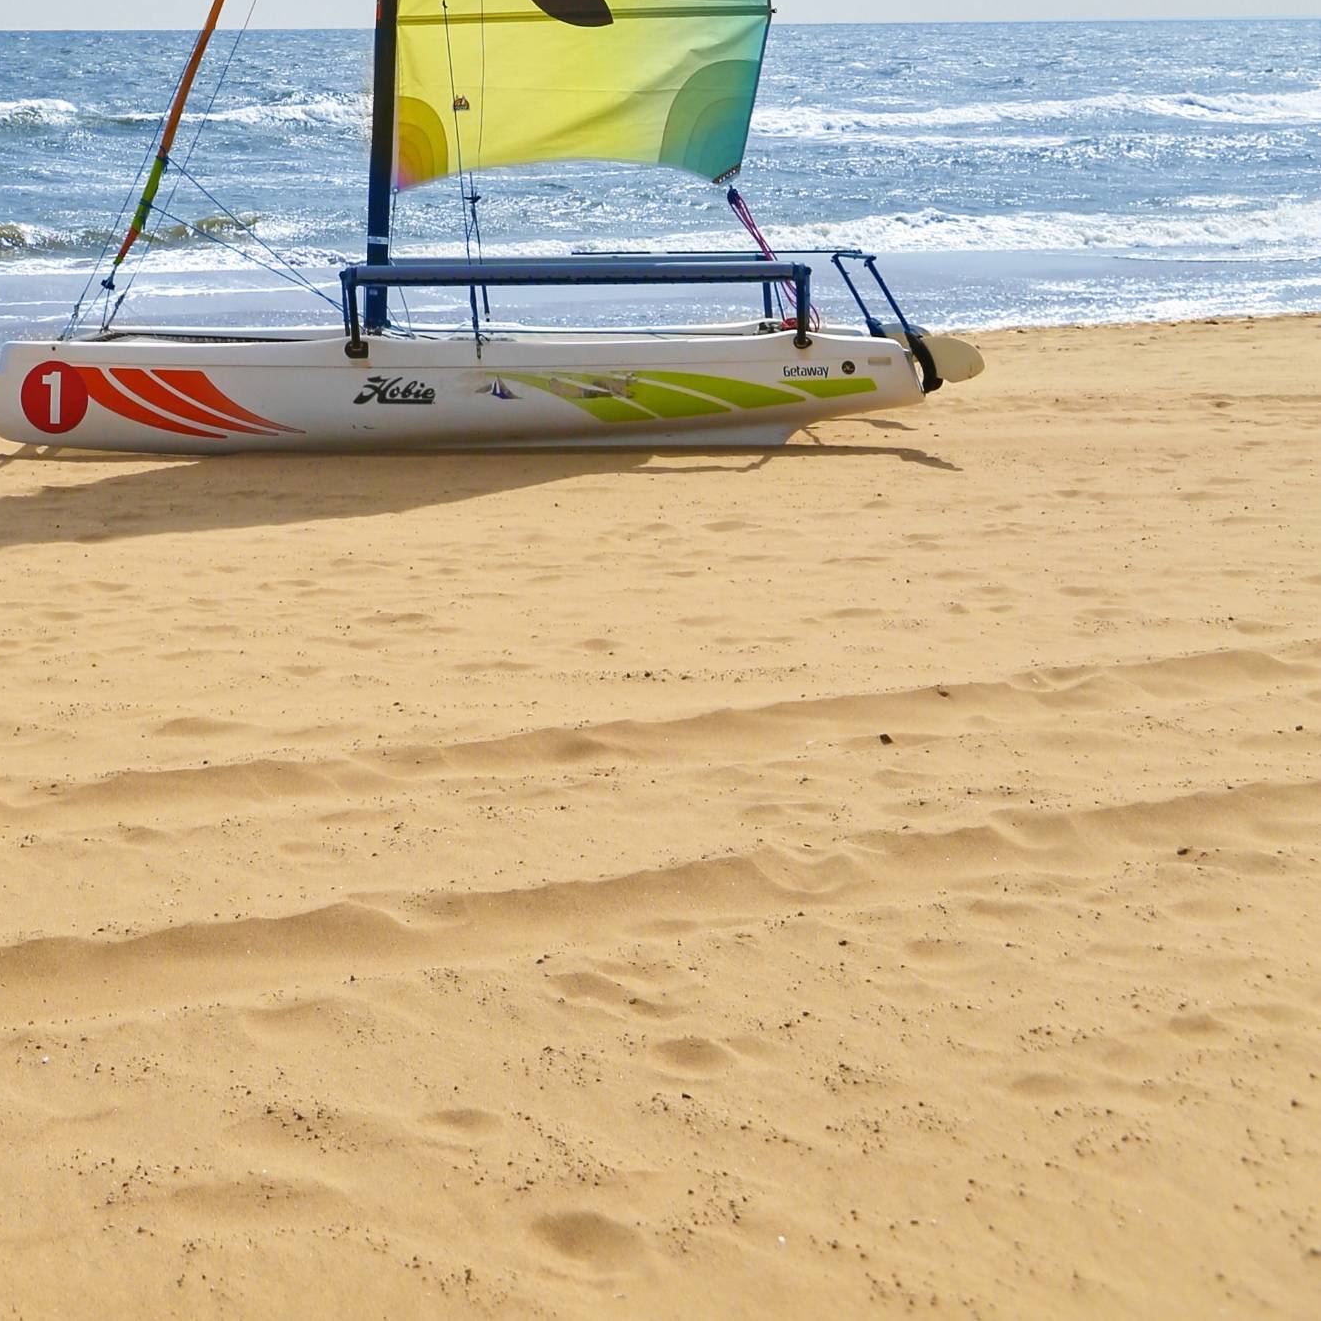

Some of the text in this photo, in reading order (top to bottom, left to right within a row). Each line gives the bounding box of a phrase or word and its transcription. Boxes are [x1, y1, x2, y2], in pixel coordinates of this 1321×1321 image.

[782, 365, 829, 379] Getaway
[42, 371, 62, 424] 1
[352, 375, 436, 405] Hobie
